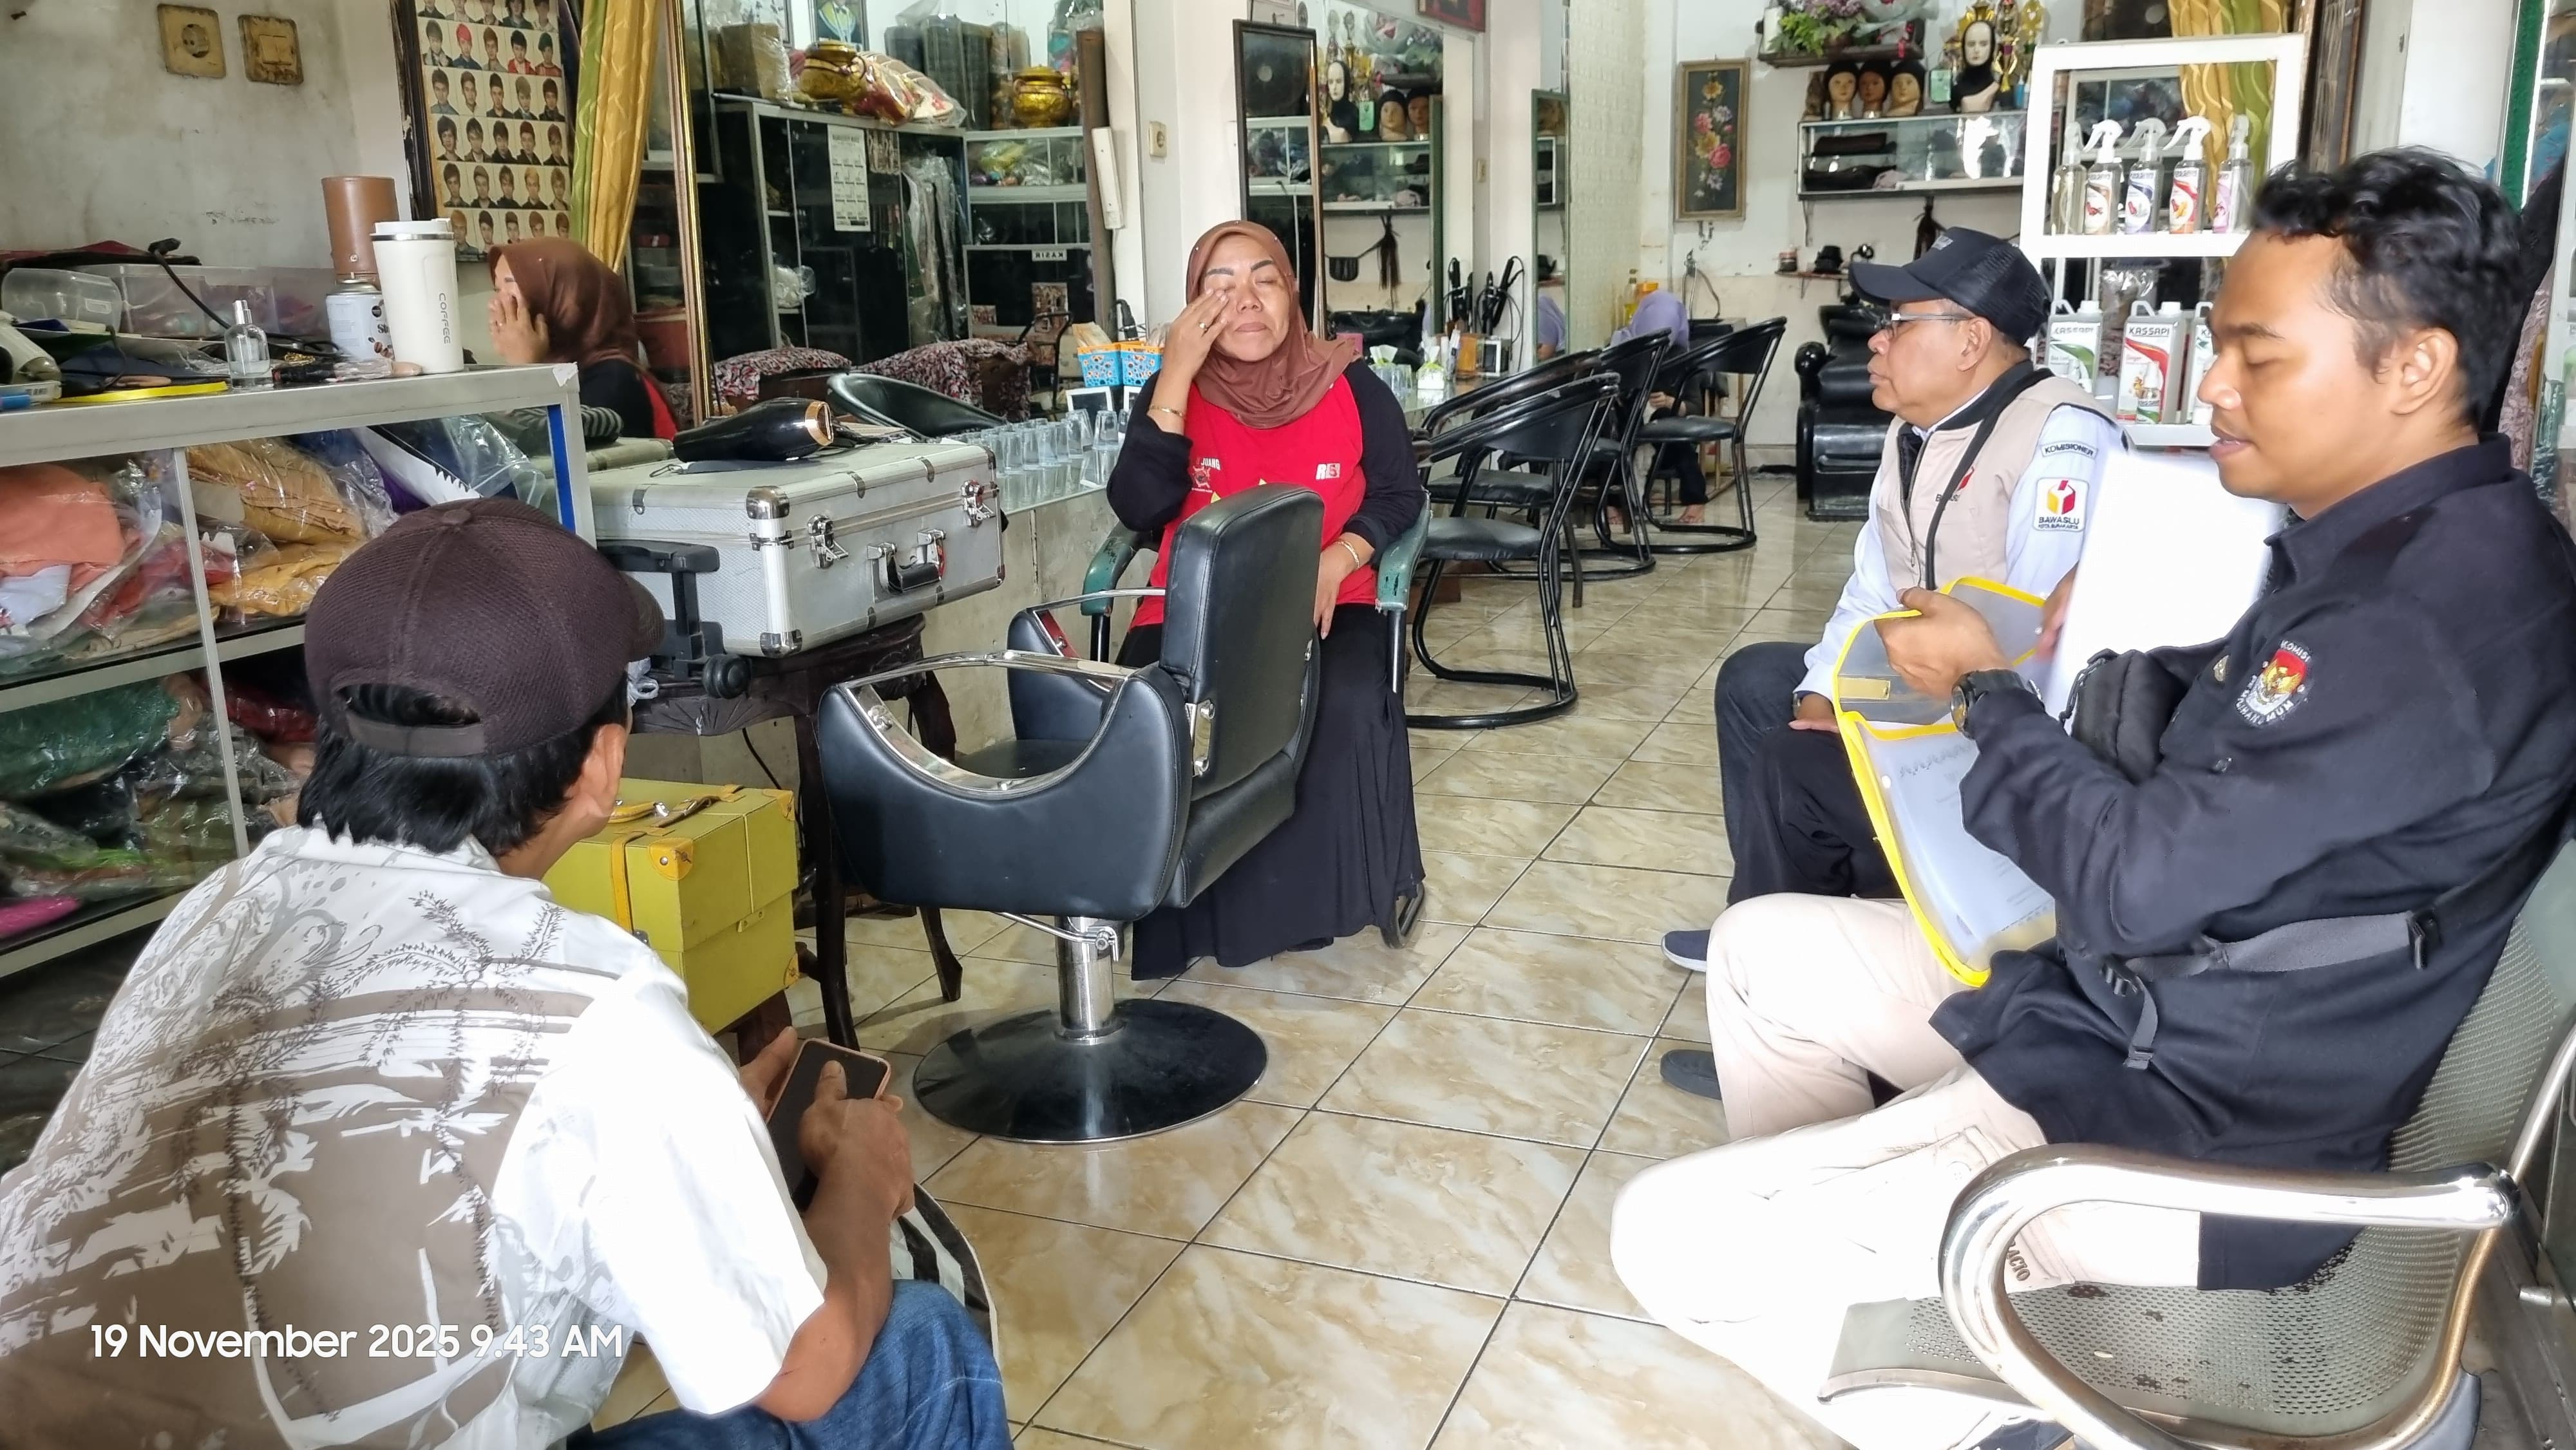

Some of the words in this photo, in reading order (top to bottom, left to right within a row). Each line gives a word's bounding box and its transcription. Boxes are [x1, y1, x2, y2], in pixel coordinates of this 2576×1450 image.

[439, 292, 451, 344] COFFEE
[2128, 326, 2170, 335] KASSAPI
[2045, 444, 2094, 456] KOMISIONER
[2039, 516, 2079, 525] BAWASLU
[2280, 640, 2311, 663] KOMISI
